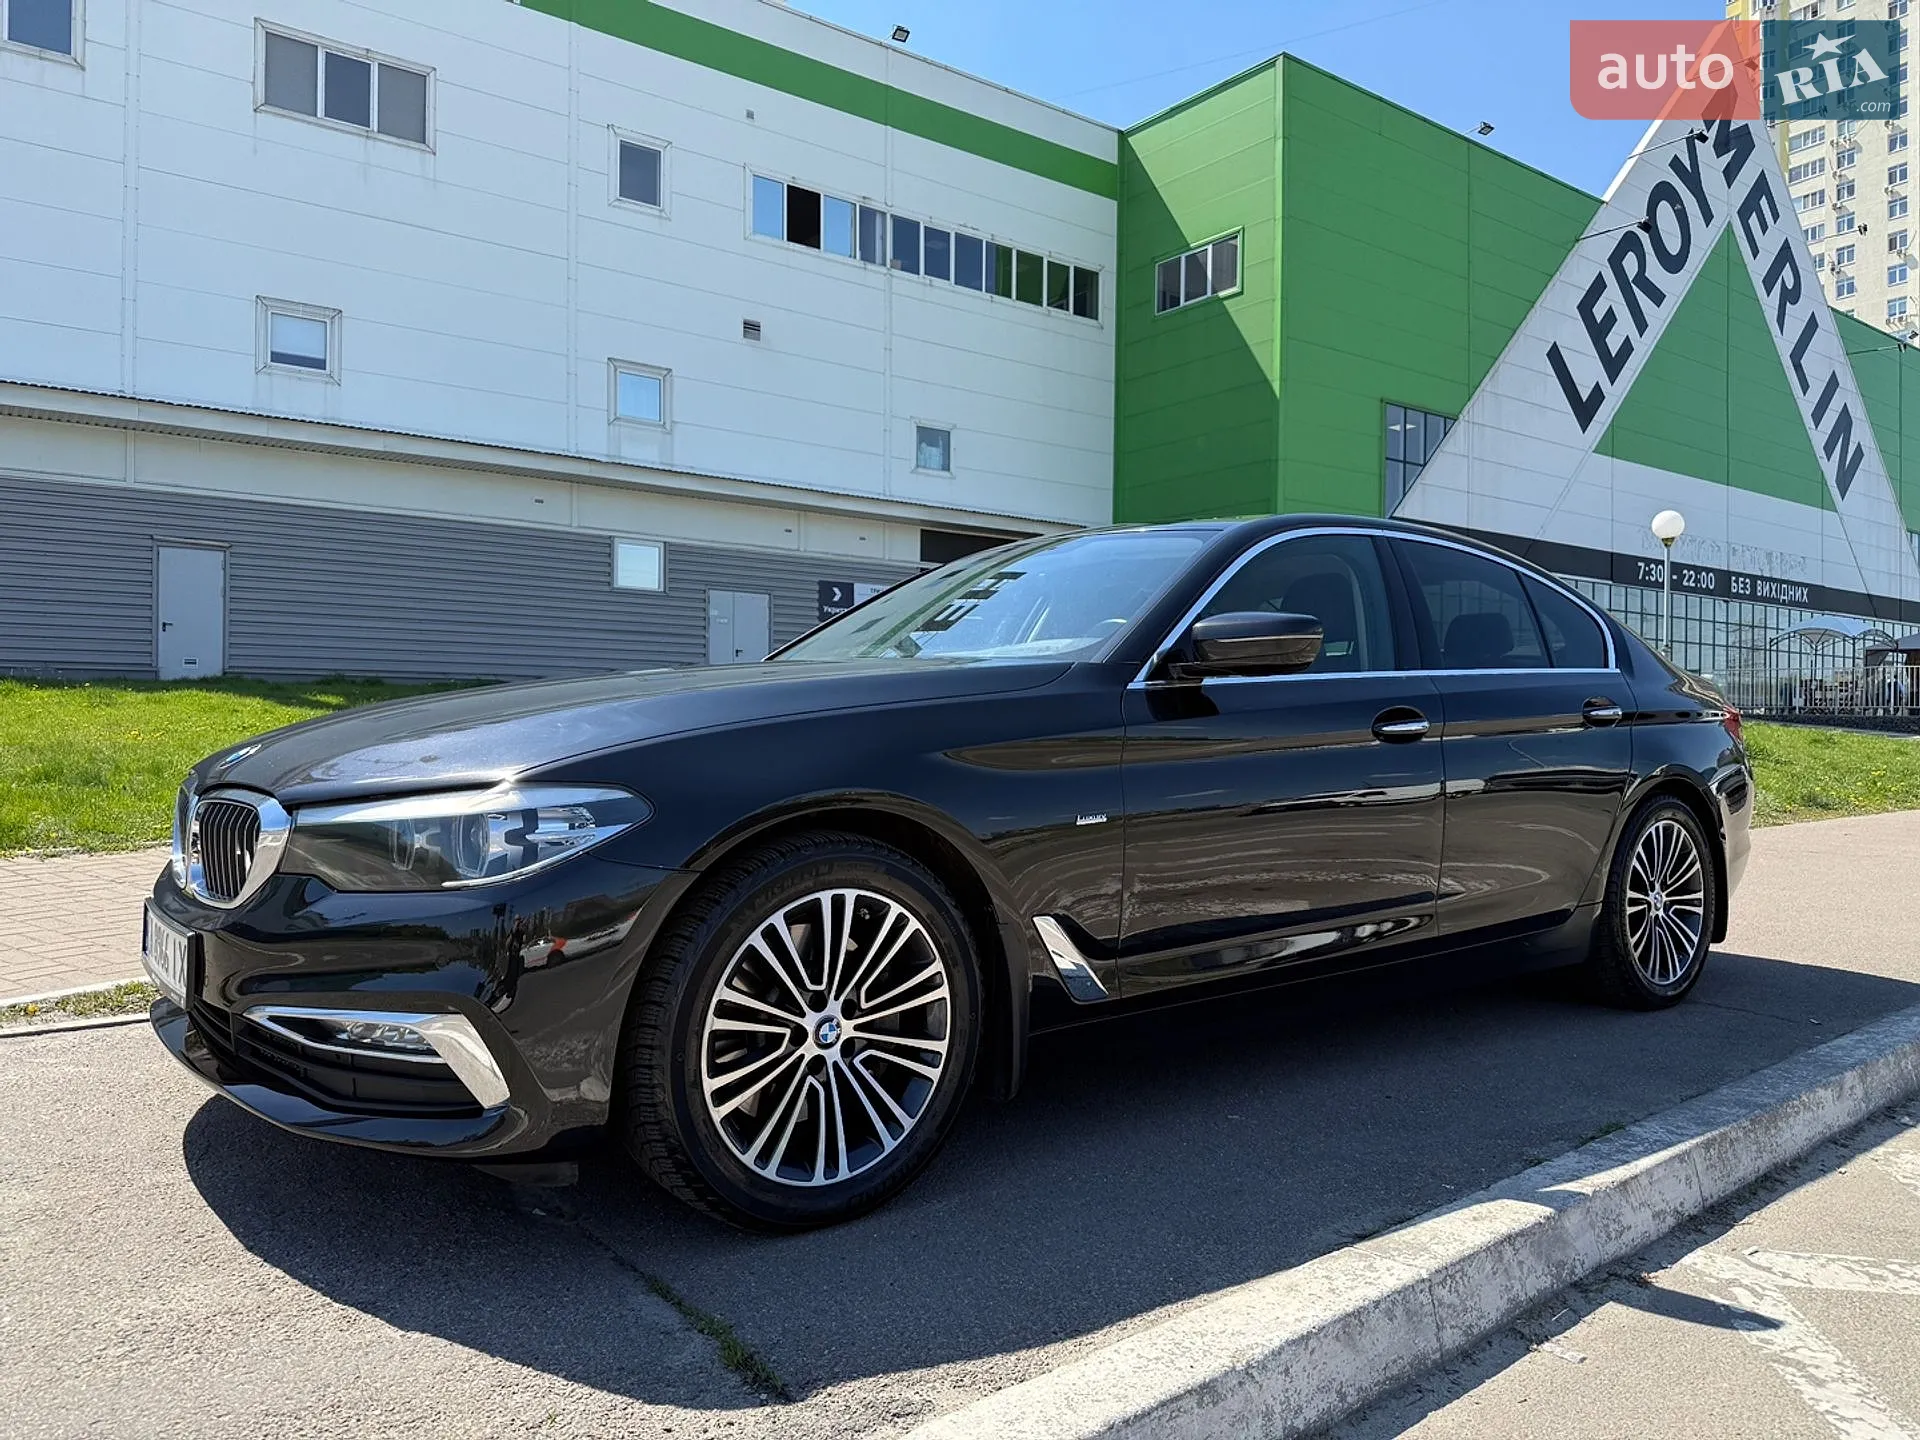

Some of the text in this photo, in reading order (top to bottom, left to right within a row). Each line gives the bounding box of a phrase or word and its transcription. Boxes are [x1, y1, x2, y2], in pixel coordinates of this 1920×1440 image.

[1546, 84, 1865, 502] LEROY MERLIN
[1637, 561, 1664, 583] 7:30
[1682, 569, 1715, 590] 22:00
[1731, 576, 1751, 595] БЕЗ
[1757, 580, 1809, 603] ВИХІДНИХ
